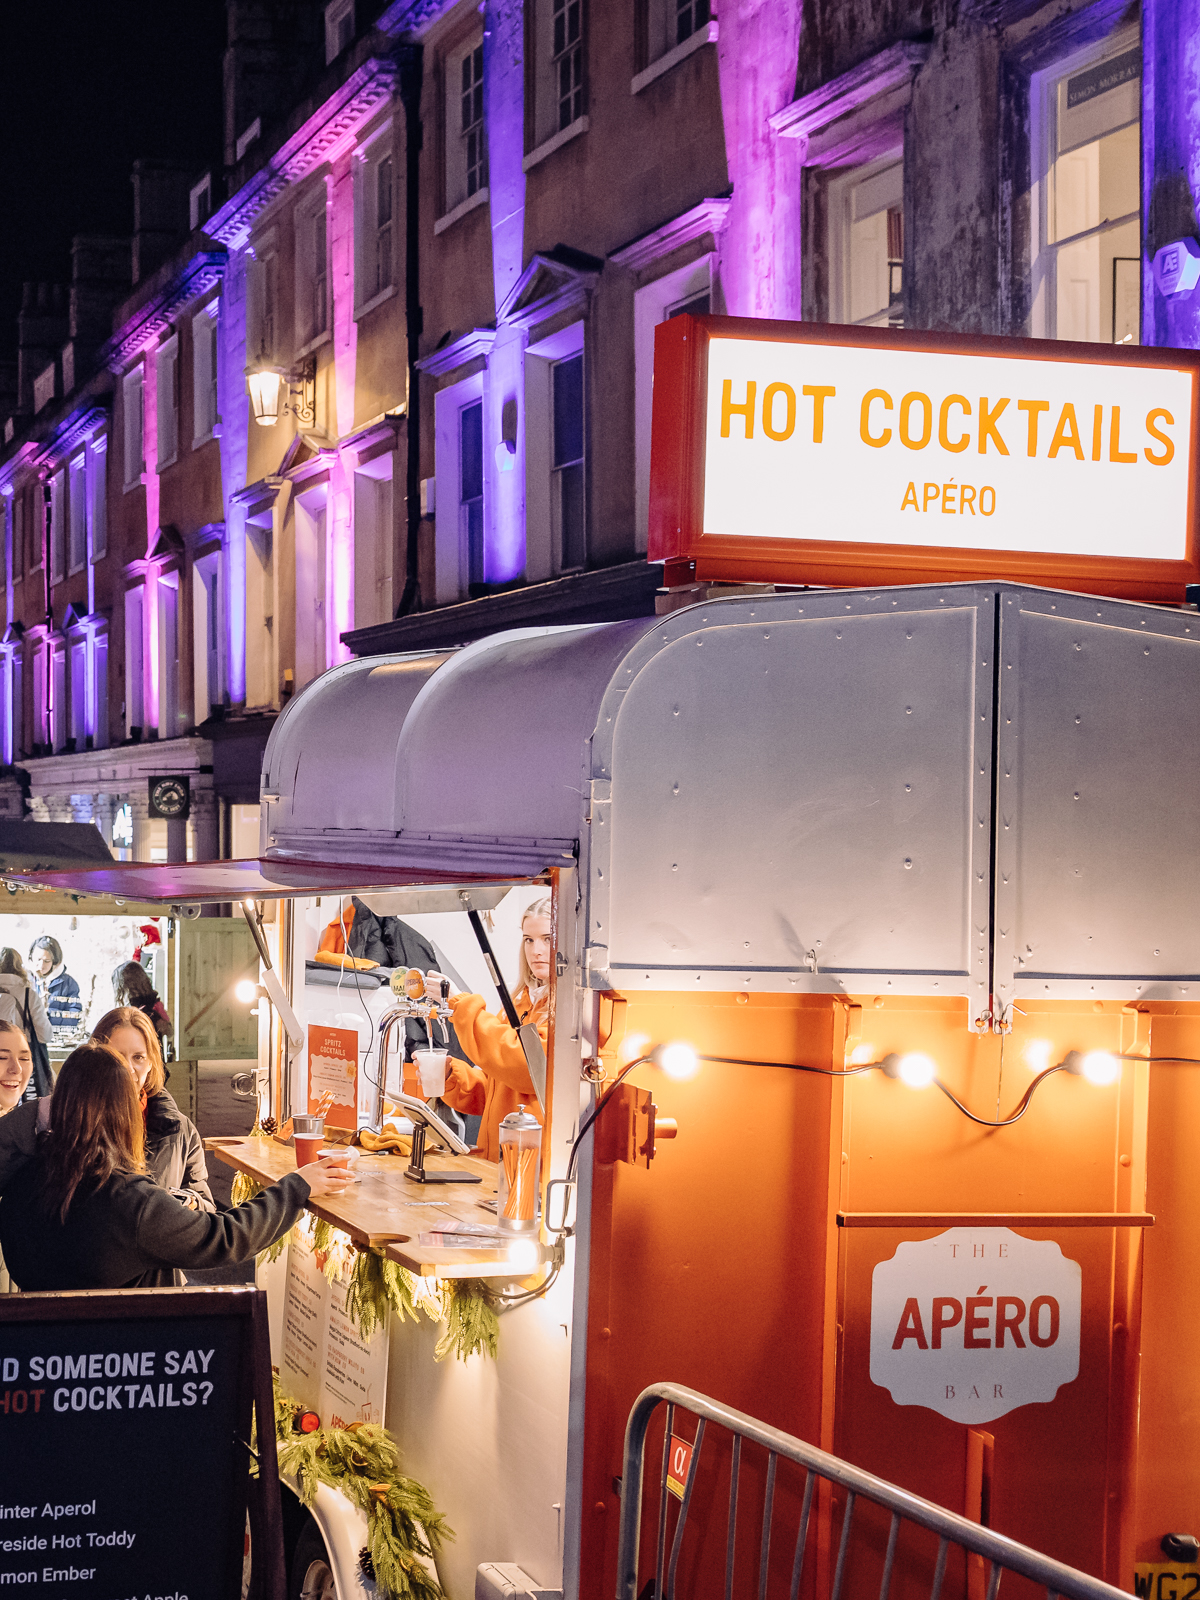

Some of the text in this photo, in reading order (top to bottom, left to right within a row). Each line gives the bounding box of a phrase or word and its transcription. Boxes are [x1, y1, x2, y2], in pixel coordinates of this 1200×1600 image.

[721, 379, 1174, 466] HOT COCKTAILS
[901, 478, 996, 516] APÉRO
[320, 1046, 345, 1056] COCKTAILS
[324, 1039, 341, 1047] SPRITZ
[949, 1243, 1009, 1258] THE
[892, 1285, 1060, 1350] APÉRO
[29, 1352, 155, 1381] SOMEONE
[164, 1349, 215, 1374] SAY
[53, 1381, 214, 1412] COCKTAILS?
[945, 1384, 1004, 1399] BAR
[41, 1500, 96, 1523] Aperol
[52, 1534, 82, 1549] Hot
[86, 1531, 136, 1549] Toddy
[42, 1566, 97, 1582] Ember
